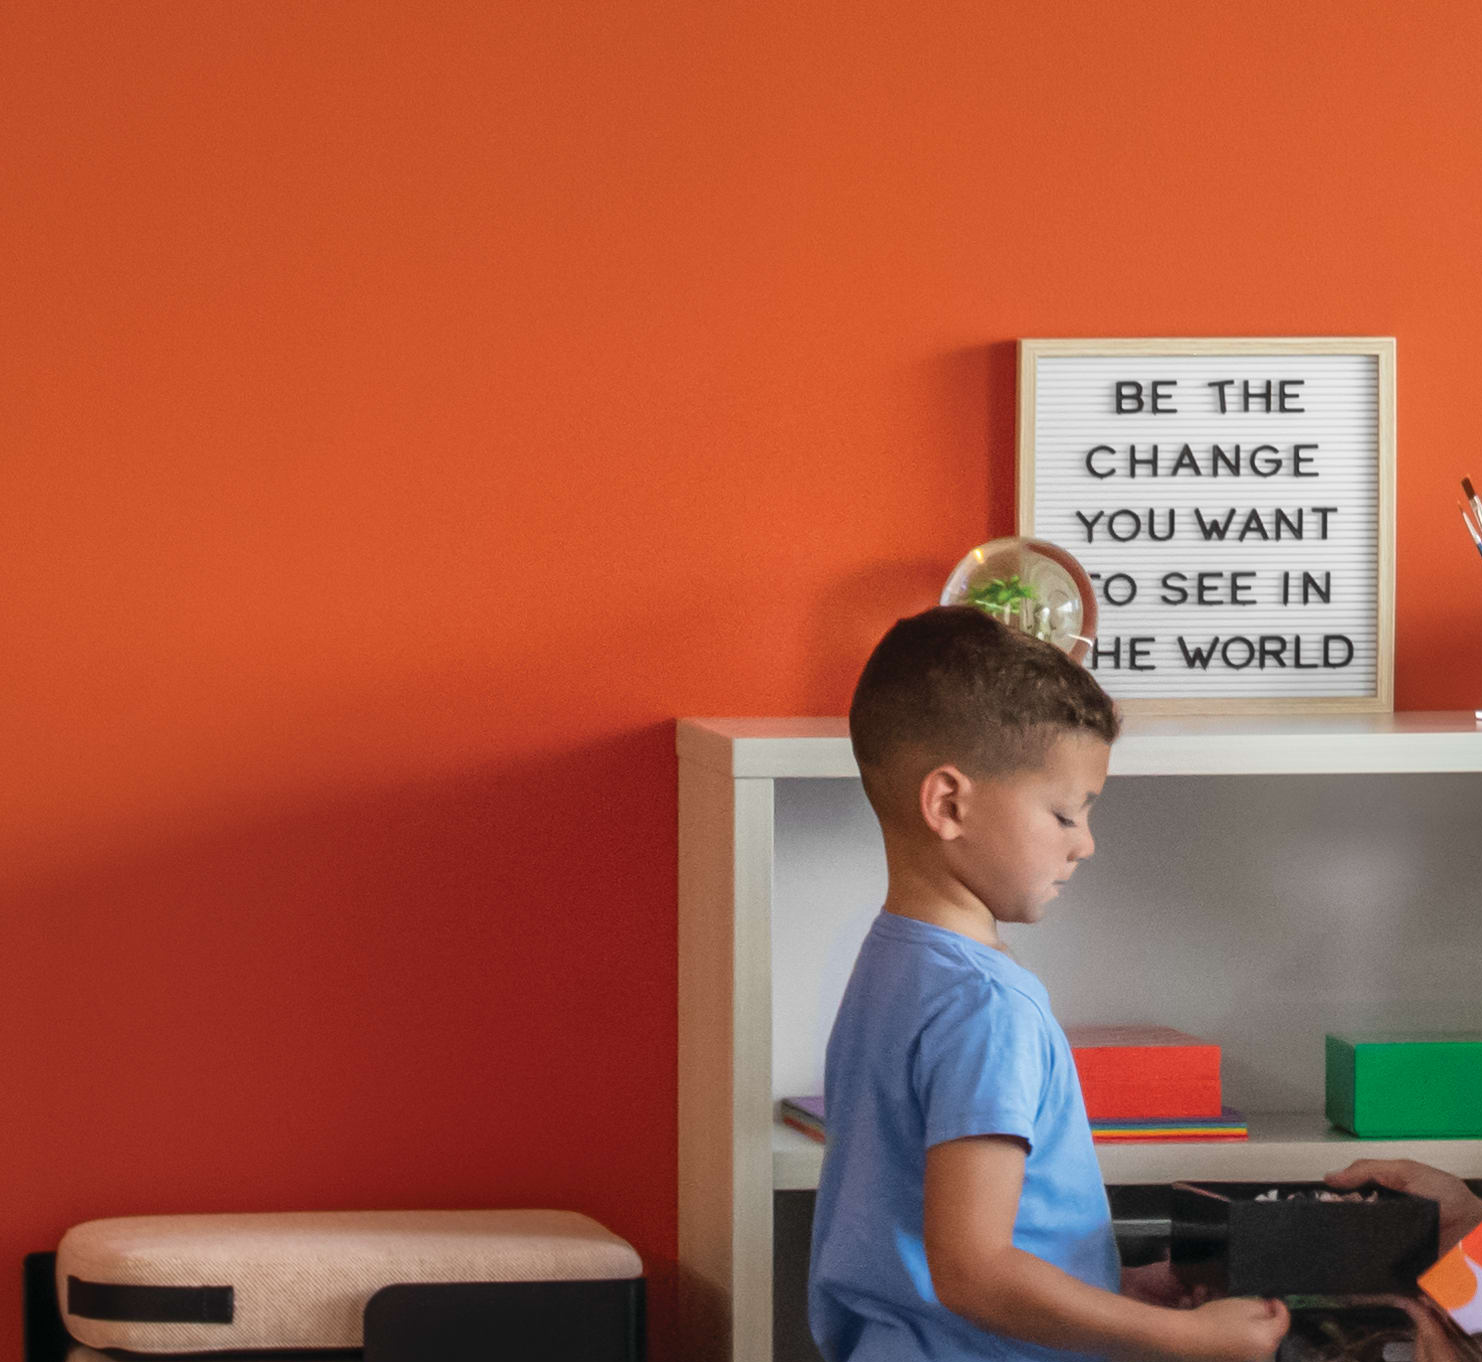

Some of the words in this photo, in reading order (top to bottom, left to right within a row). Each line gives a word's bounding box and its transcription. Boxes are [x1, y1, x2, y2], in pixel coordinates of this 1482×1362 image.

[1115, 380, 1178, 415] BE
[1207, 379, 1305, 415] THE
[1085, 443, 1319, 480] CHANGE
[1075, 507, 1176, 544] YOU
[1193, 507, 1338, 543] WANT
[1090, 572, 1138, 607] O
[1160, 571, 1257, 606] SEE
[1282, 571, 1331, 607] IN
[1091, 636, 1157, 671] HE
[1177, 634, 1355, 671] WORLD
